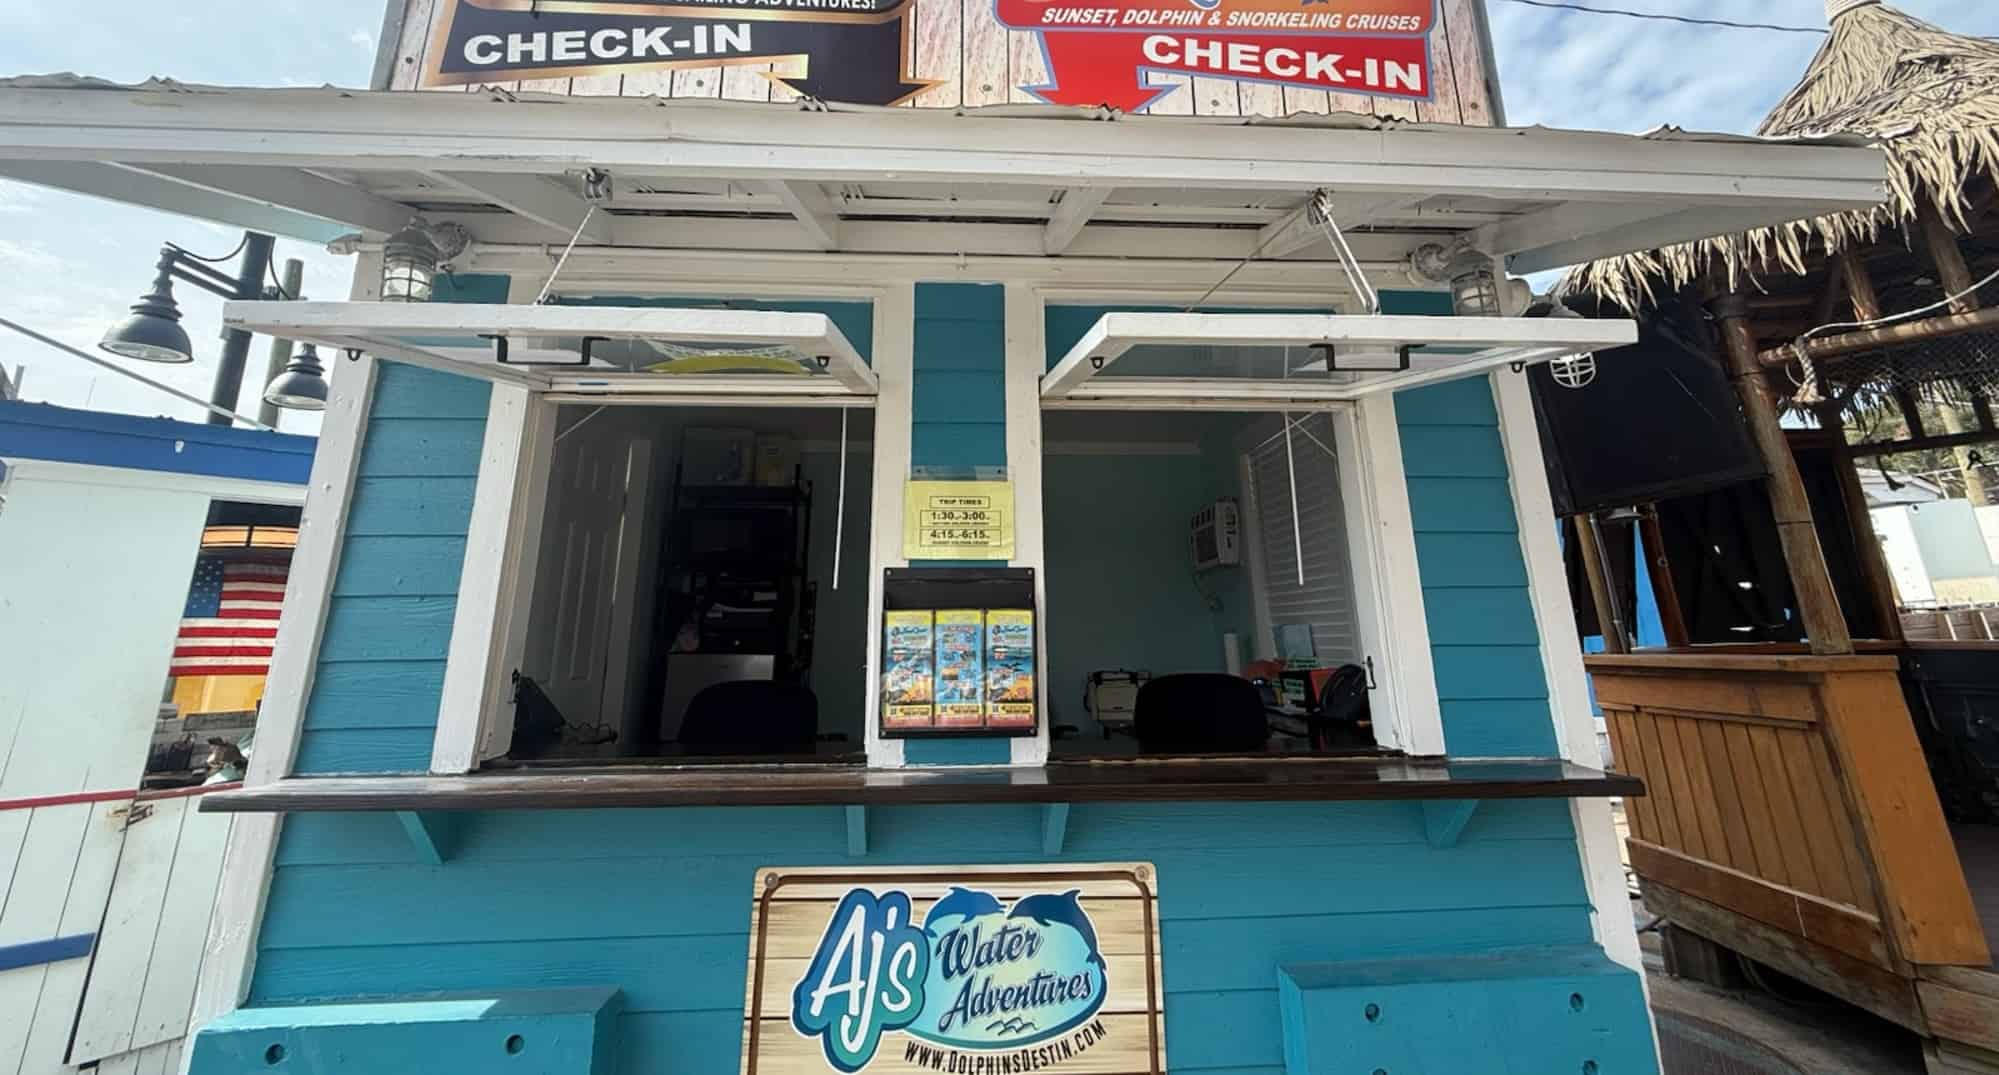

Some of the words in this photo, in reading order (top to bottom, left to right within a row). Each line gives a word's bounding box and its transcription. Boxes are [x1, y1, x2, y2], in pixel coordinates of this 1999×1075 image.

[463, 23, 752, 65] CHECK-IN
[1041, 7, 1118, 27] SUNSET,
[1122, 9, 1205, 27] DOLPHIN
[1207, 10, 1223, 27] &
[1226, 11, 1343, 30] SNORKELING
[1346, 14, 1421, 32] CRUISES
[1142, 34, 1422, 92] CHECK-IN
[935, 921, 1045, 979] Water
[938, 968, 1095, 1033] Adventures
